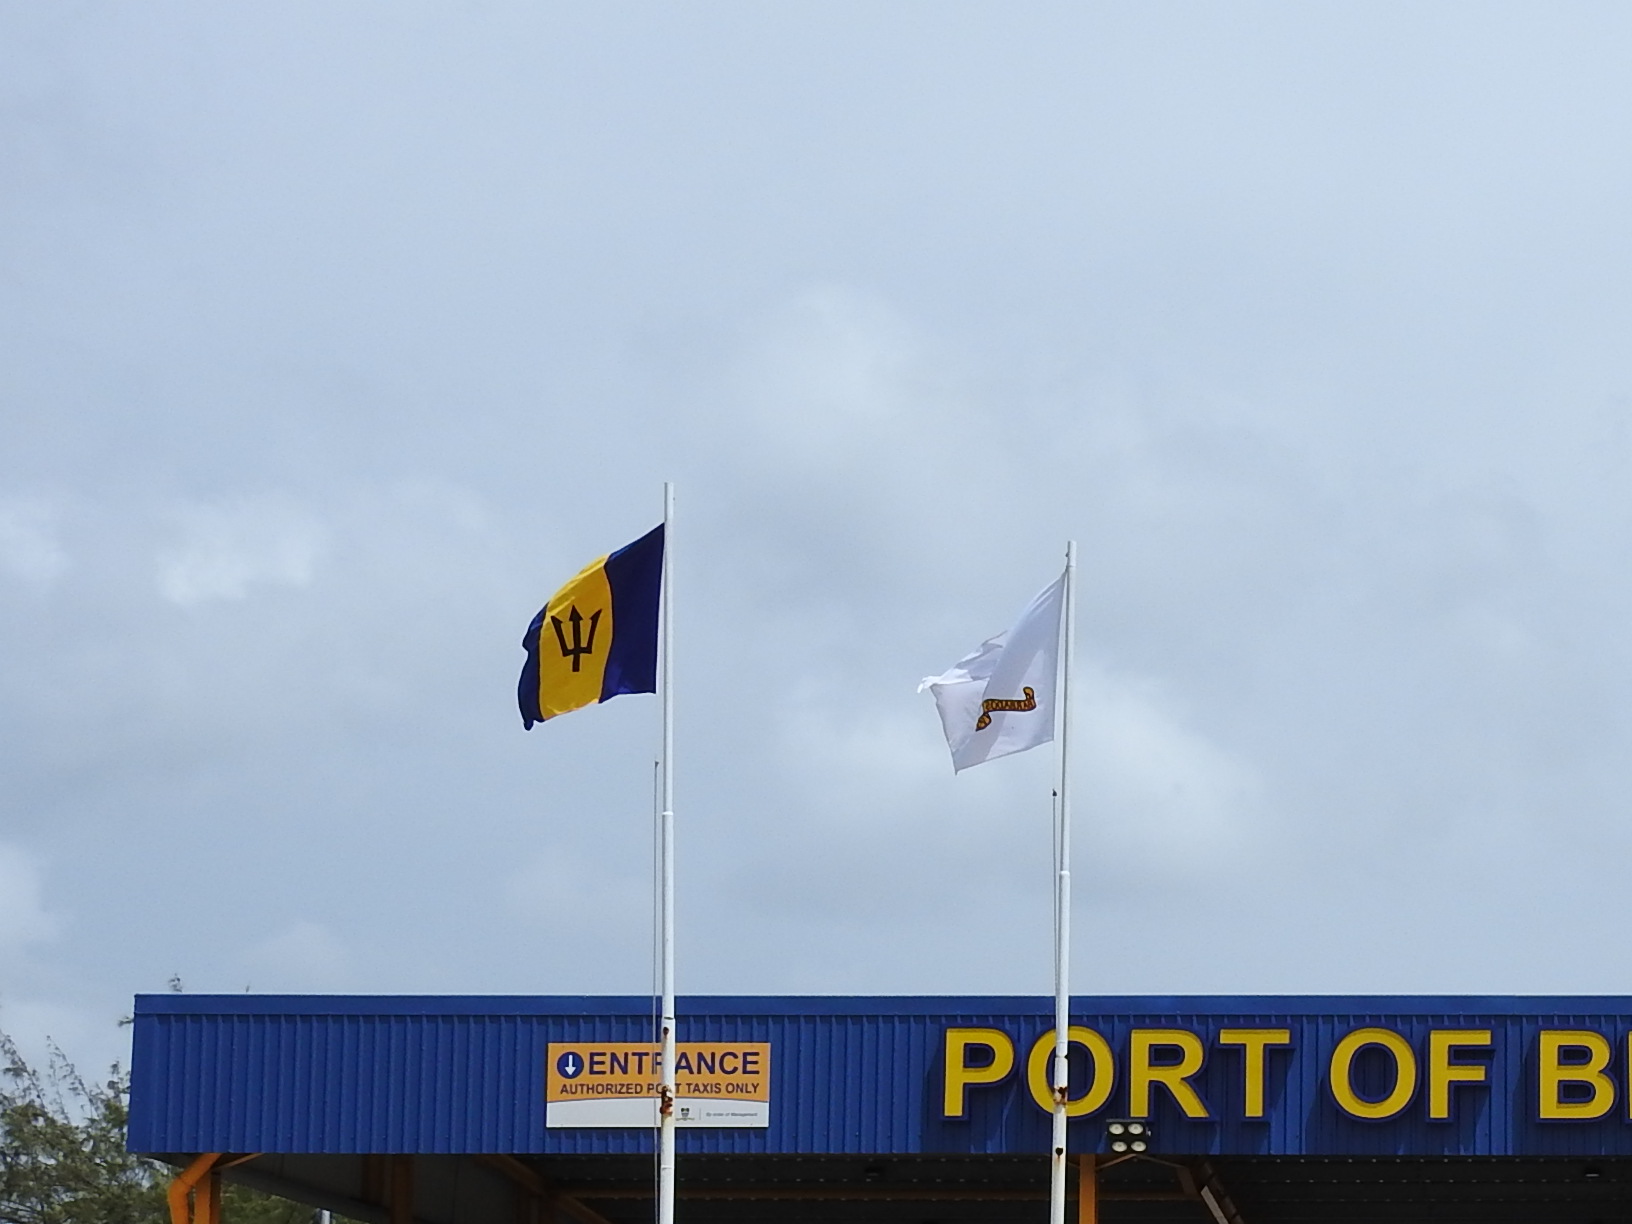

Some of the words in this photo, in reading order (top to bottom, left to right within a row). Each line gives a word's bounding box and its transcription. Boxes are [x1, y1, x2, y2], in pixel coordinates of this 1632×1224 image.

[560, 1083, 643, 1095] AUTHORIZED
[647, 1083, 682, 1095] POT
[686, 1082, 722, 1094] TAXIS
[725, 1082, 760, 1094] ONLY
[944, 1026, 1291, 1118] PORT
[1329, 1027, 1492, 1119] OF
